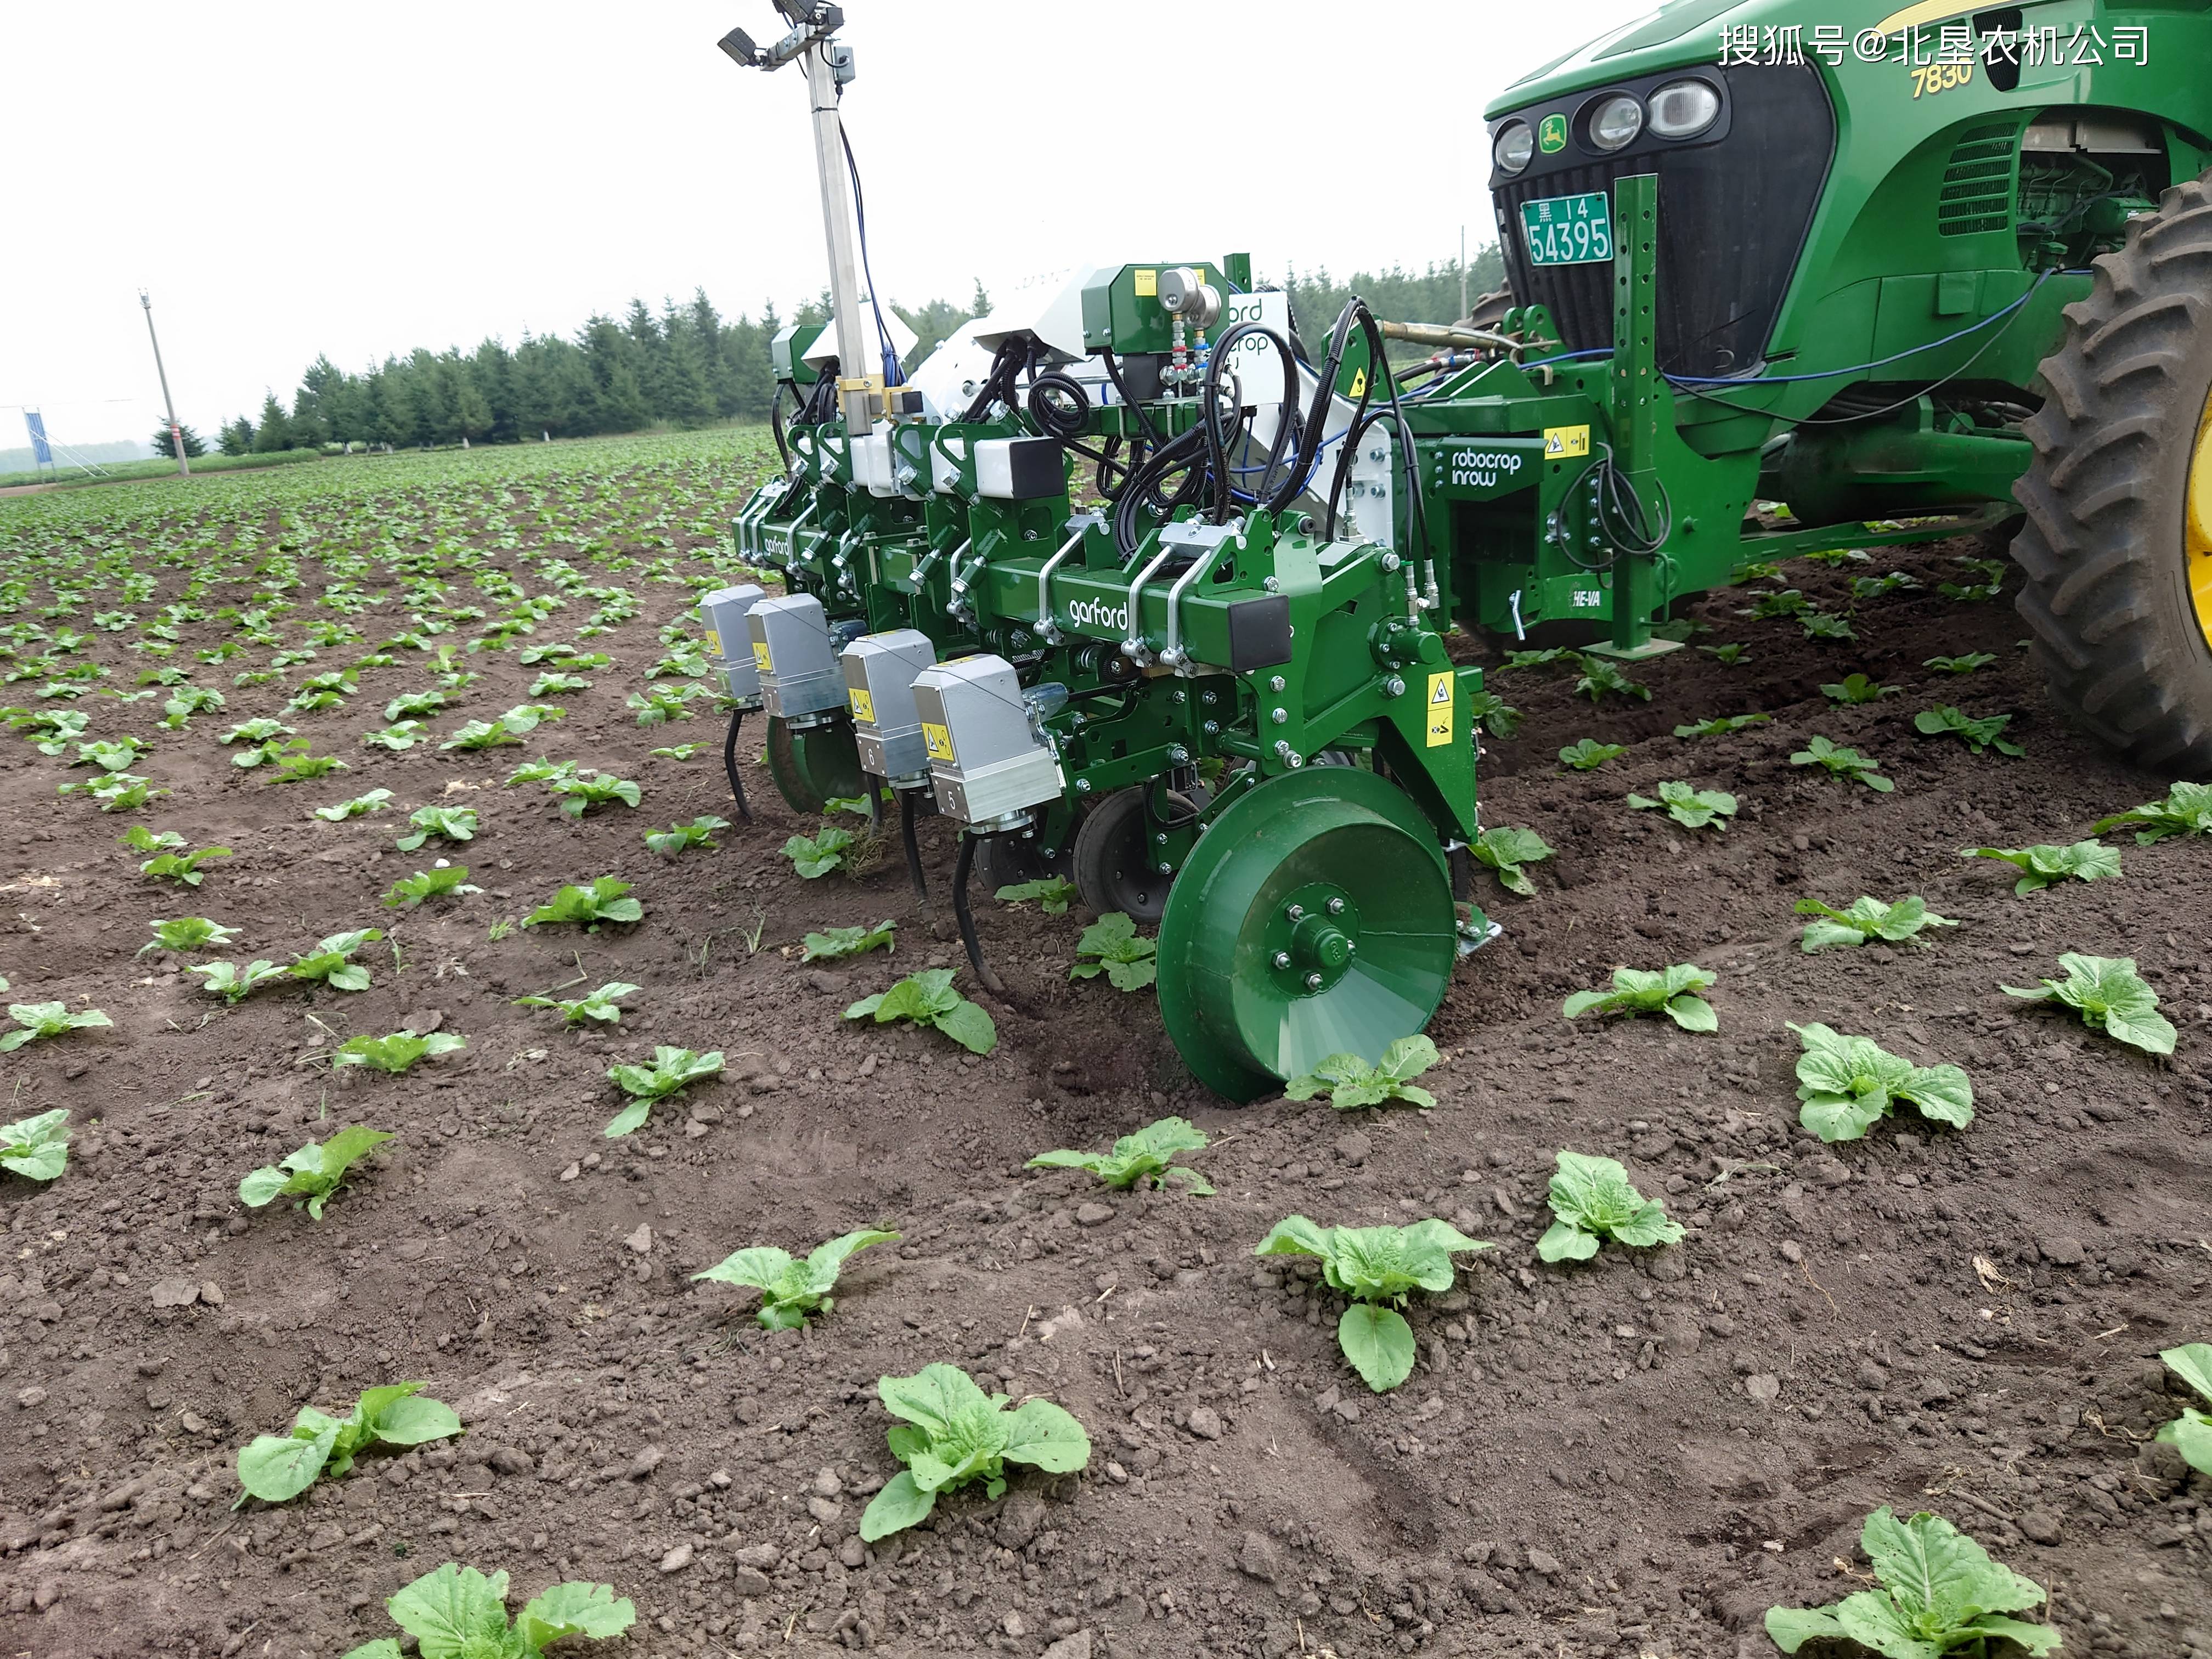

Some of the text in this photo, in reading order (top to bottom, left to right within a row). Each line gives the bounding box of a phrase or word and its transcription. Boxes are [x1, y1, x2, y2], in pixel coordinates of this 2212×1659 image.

[1911, 57, 1973, 99] 7830
[1538, 202, 1553, 223] 黑
[1528, 218, 1609, 262] 54395
[1452, 447, 1522, 476] robocrop
[1452, 469, 1497, 487] inrow
[765, 535, 789, 556] garford
[1572, 590, 1600, 607] HE-VA
[1069, 596, 1128, 631] garford
[868, 748, 875, 766] 6
[947, 791, 956, 810] 5
